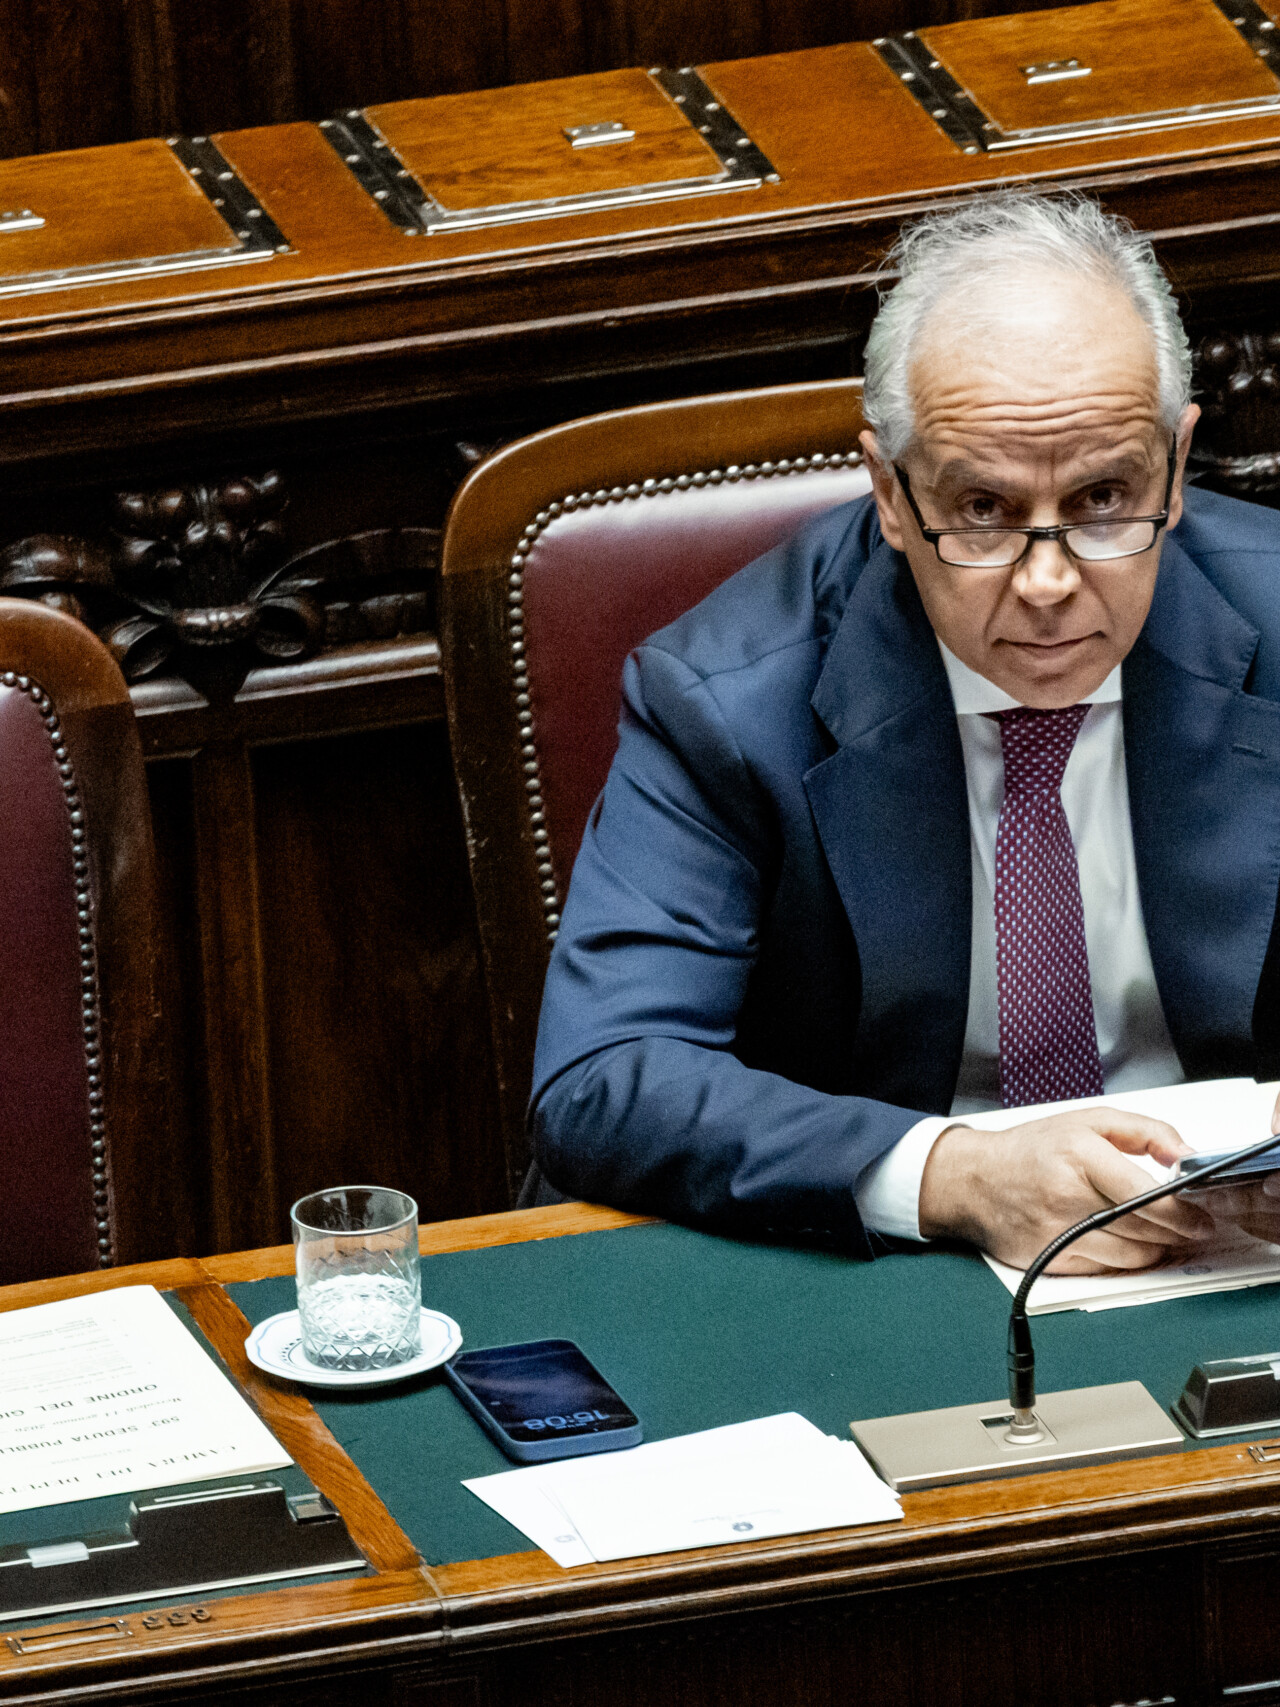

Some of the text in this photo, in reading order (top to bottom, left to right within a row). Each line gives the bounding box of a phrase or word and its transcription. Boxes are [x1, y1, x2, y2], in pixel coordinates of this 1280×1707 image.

[84, 1383, 158, 1404] ORDINE
[34, 1400, 72, 1411] DEL
[523, 1409, 610, 1430] 15:08
[71, 1425, 138, 1441] SEDUTA
[147, 1445, 237, 1467] CAMERA
[96, 1467, 132, 1479] DEI
